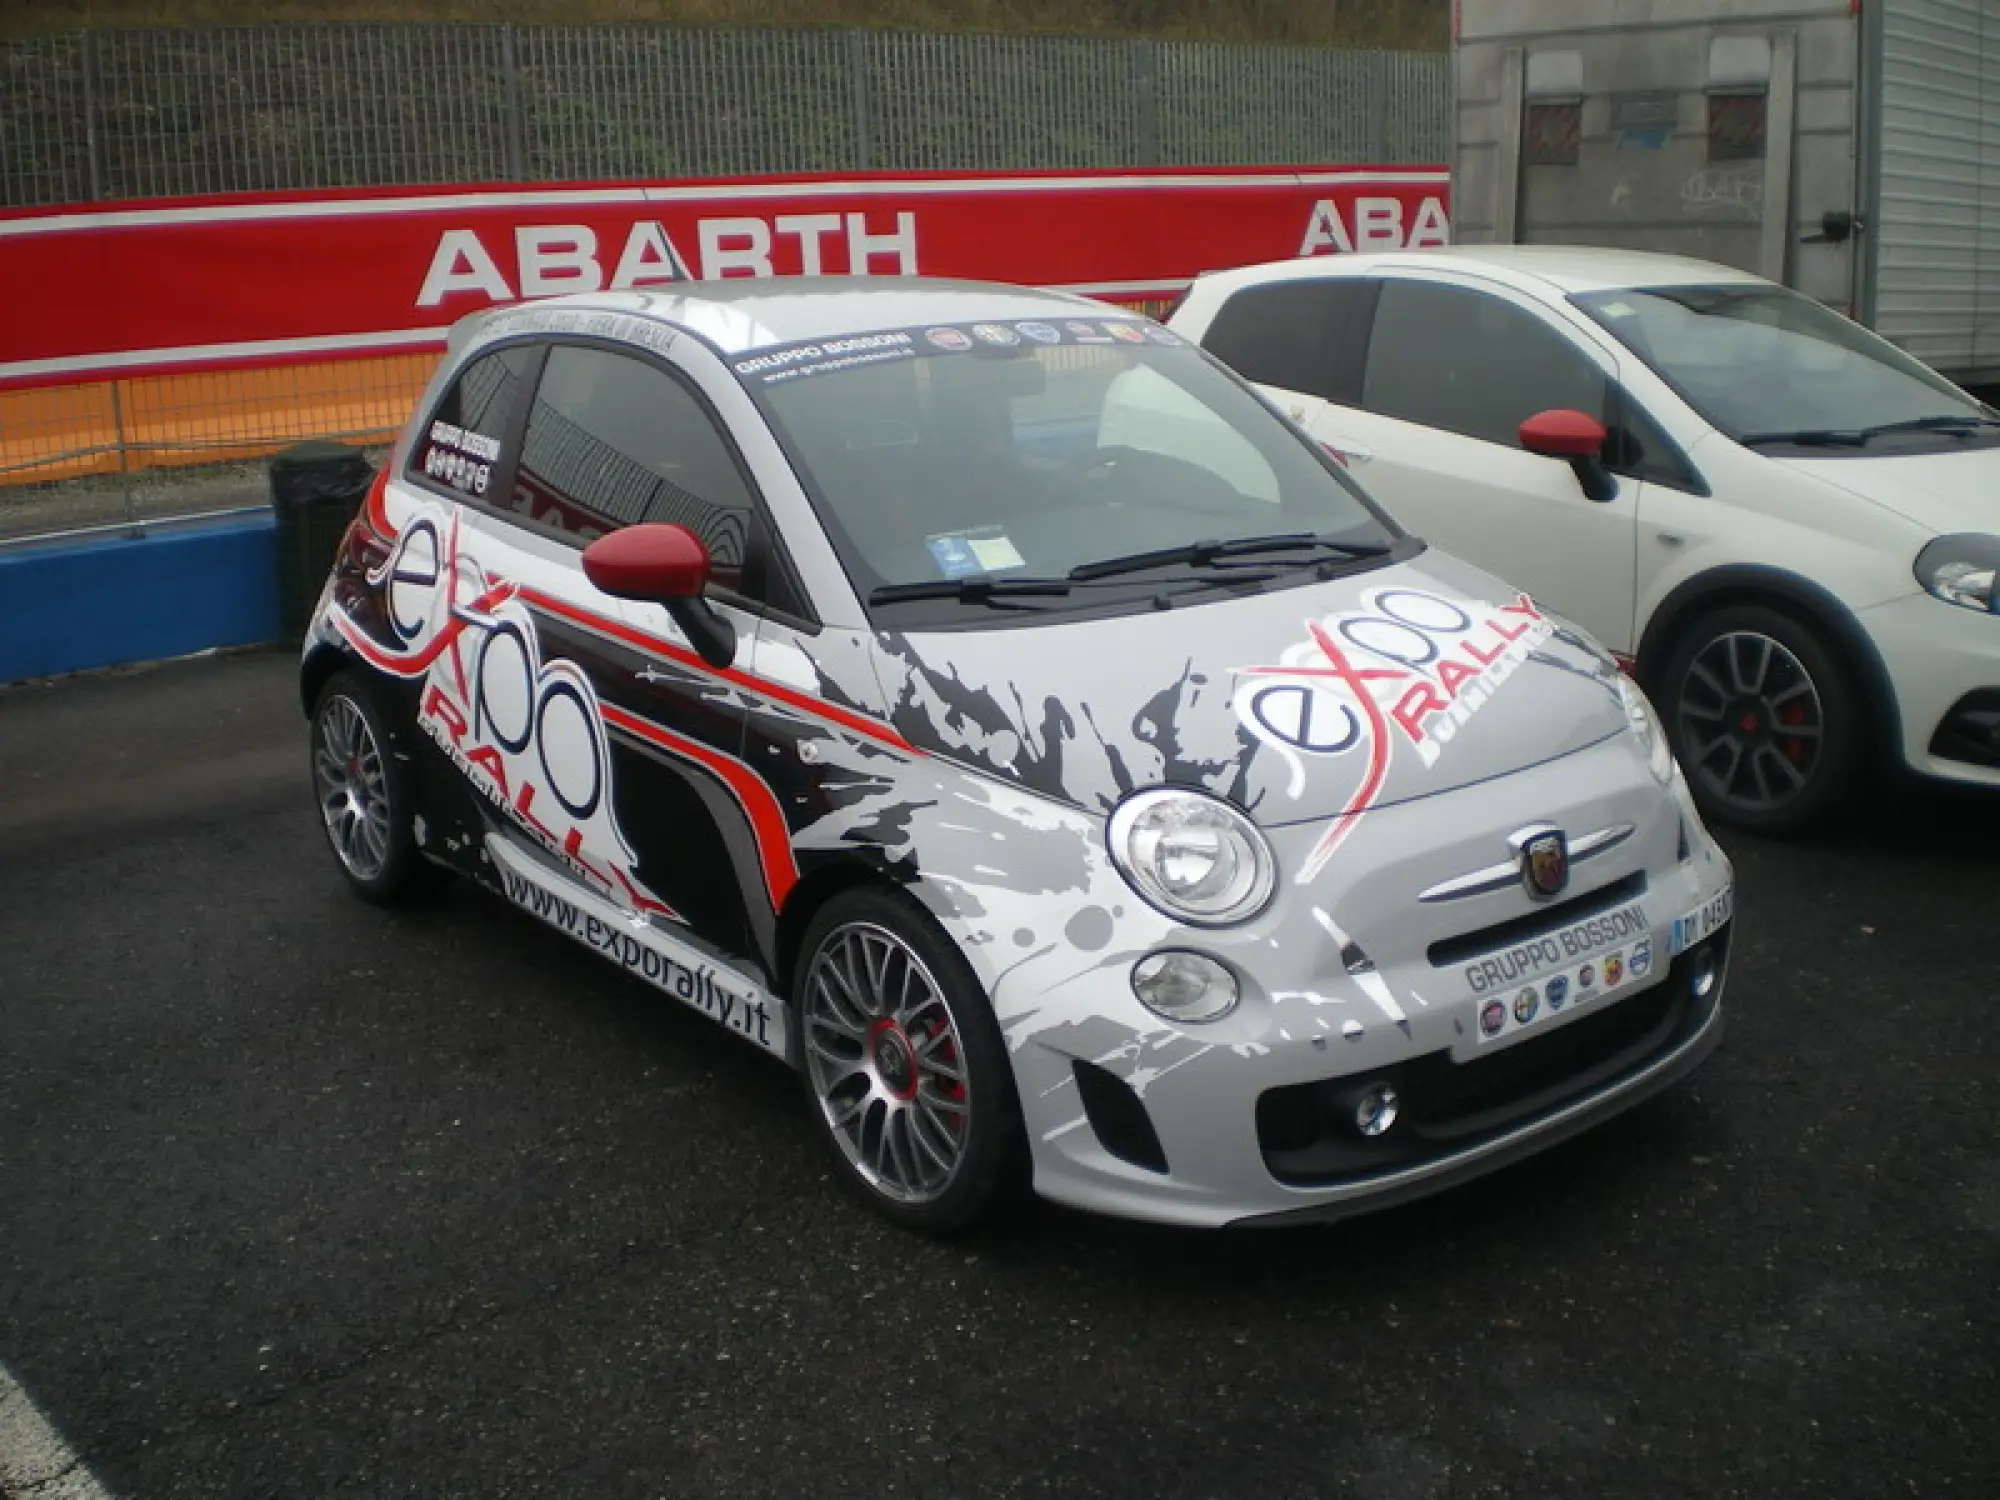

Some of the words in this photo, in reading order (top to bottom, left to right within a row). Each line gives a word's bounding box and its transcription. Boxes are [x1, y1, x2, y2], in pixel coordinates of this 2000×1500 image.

[414, 211, 919, 307] ABARTH
[1300, 196, 1450, 256] ABA
[1389, 592, 1542, 743] RALLY
[423, 684, 676, 917] RALLY
[504, 870, 771, 1046] www.exporally.it
[1464, 938, 1561, 993] GRUPPO
[1559, 904, 1649, 957] BOSSONI
